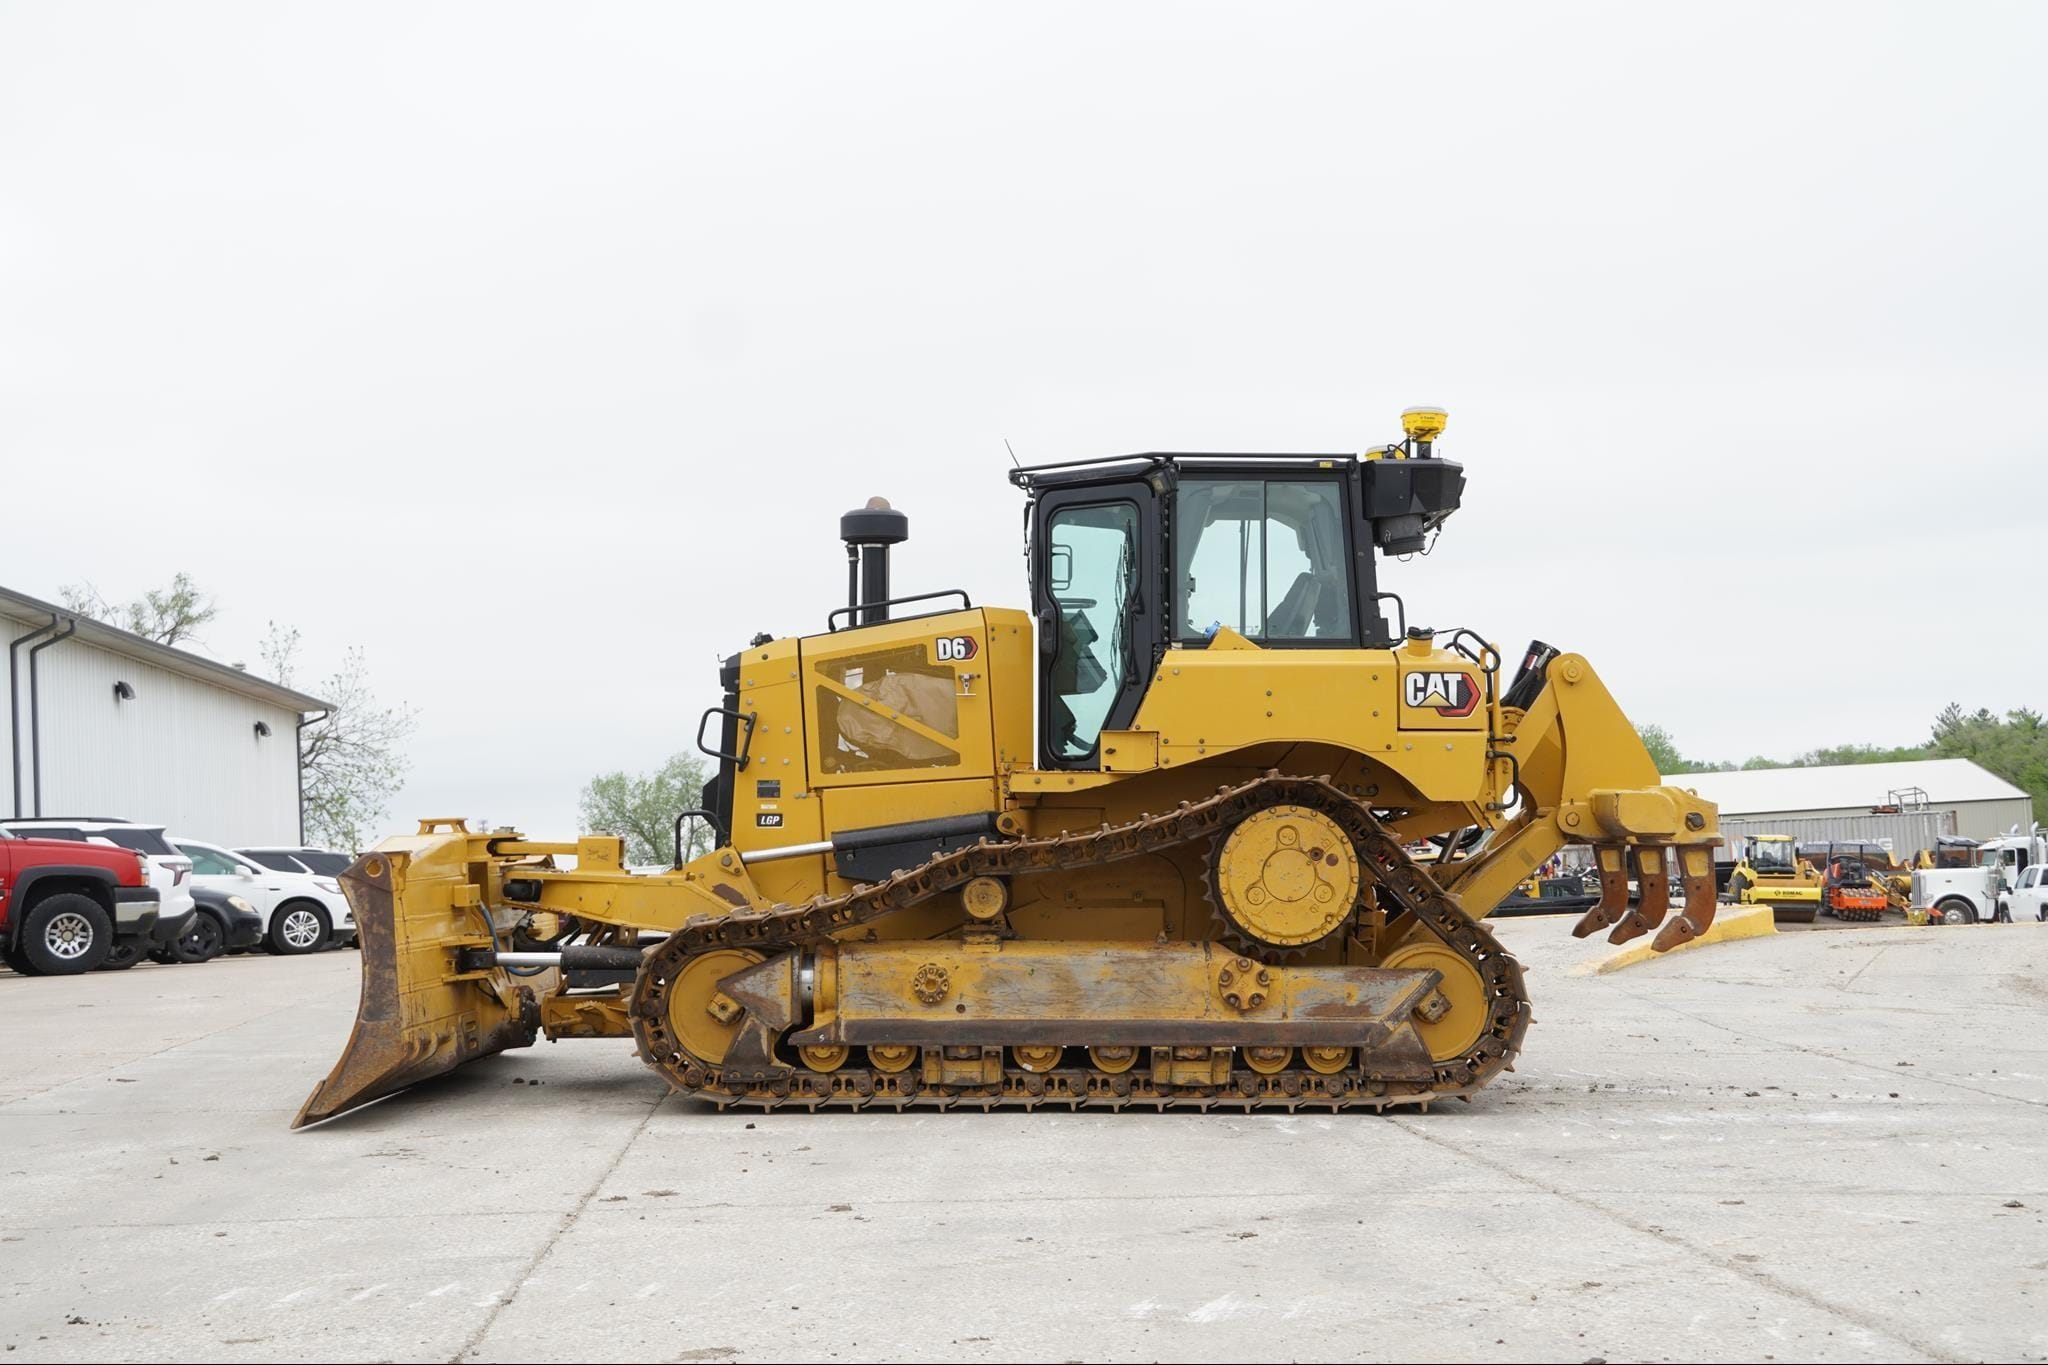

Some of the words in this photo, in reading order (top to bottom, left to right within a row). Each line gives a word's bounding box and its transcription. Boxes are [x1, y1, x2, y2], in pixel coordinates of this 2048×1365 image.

[937, 637, 966, 660] D6
[1406, 672, 1462, 707] CAT
[760, 815, 780, 825] LGP
